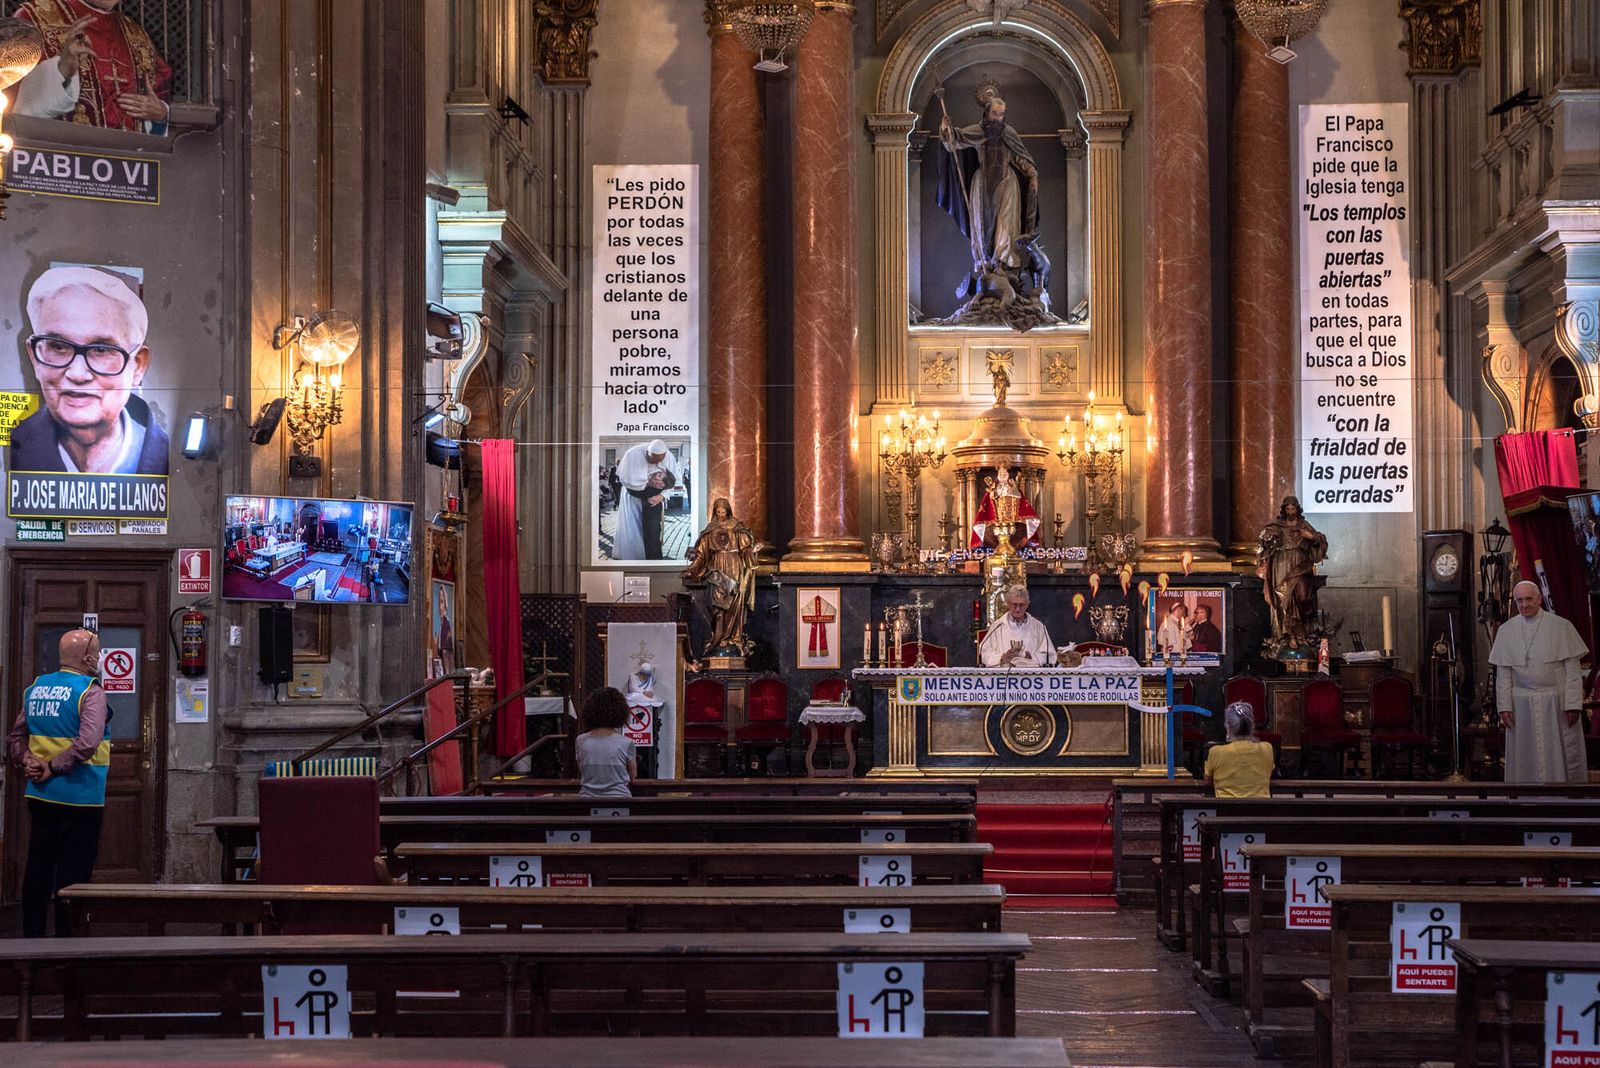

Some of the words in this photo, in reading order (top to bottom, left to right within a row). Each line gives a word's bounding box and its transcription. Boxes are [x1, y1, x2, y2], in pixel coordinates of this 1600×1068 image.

[1326, 116, 1340, 131] El
[1346, 116, 1384, 135] Papa
[1317, 136, 1393, 152] Francisco
[13, 150, 113, 182] PABLO
[122, 161, 148, 186] VI
[1313, 158, 1345, 177] pide
[1351, 160, 1379, 176] que
[1385, 157, 1398, 172] la
[650, 178, 685, 194] pido
[1306, 178, 1356, 198] Iglesia
[1361, 179, 1404, 197] tenga
[608, 193, 683, 210] PERDÓN
[1344, 203, 1406, 224] templos
[608, 218, 634, 232] por
[639, 215, 684, 228] todas
[608, 234, 631, 247] las
[637, 236, 684, 247] veces
[1326, 230, 1355, 243] con
[1360, 226, 1383, 243] las
[616, 255, 646, 268] que
[652, 252, 675, 265] los
[1324, 249, 1384, 270] puertas
[606, 271, 686, 284] cristianos
[604, 289, 663, 302] delante
[669, 289, 688, 302] de
[1322, 296, 1340, 308] en
[1345, 293, 1389, 308] todas
[631, 310, 660, 321] una
[1310, 313, 1362, 332] partes,
[1368, 315, 1402, 331] para
[613, 329, 679, 342] persona
[1316, 336, 1344, 351] que
[1350, 332, 1362, 347] el
[1368, 335, 1396, 350] que
[620, 344, 671, 361] pobre,
[1306, 352, 1353, 367] busca
[1358, 355, 1366, 367] a
[1372, 351, 1406, 367] Dios
[610, 363, 681, 376] miramos
[605, 381, 648, 395] hacia
[653, 382, 686, 395] otro
[1336, 375, 1355, 387] no
[1360, 375, 1378, 387] se
[624, 400, 667, 413] lado"
[1318, 392, 1396, 407] encuentre
[617, 423, 640, 433] Papa
[643, 422, 690, 431] Francisco
[1374, 414, 1390, 432] la
[1311, 437, 1380, 456] frialdad
[1384, 437, 1407, 456] de
[1309, 462, 1334, 480] las
[1339, 461, 1408, 484] puertas
[12, 480, 21, 508] P.
[24, 480, 56, 509] JOSE
[60, 481, 98, 510] MARIA
[100, 482, 116, 510] DE
[120, 483, 166, 512] LLANOS
[20, 520, 47, 530] SALIDA
[52, 521, 62, 530] DE
[79, 522, 115, 534] SERVICIOS
[18, 530, 64, 540] EMERGENCIA
[181, 582, 209, 590] EXTINTOR
[925, 678, 1044, 690] MENSAJEROS
[1050, 677, 1072, 690] DE
[1079, 677, 1100, 690] LA
[1106, 677, 1138, 690] PAZ
[925, 692, 946, 701] SOLO
[948, 692, 967, 701] ANTE
[970, 692, 988, 701] DIOS
[990, 692, 995, 701] Y
[997, 692, 1006, 701] UN
[1010, 691, 1027, 701] NIÑO
[1030, 692, 1046, 701] NOS
[1048, 692, 1086, 701] PONEMOS
[1088, 692, 1098, 701] DE
[1101, 692, 1139, 701] RODILLAS
[36, 701, 45, 717] LA
[46, 701, 61, 717] PAZ
[1422, 968, 1454, 976] PUEDES
